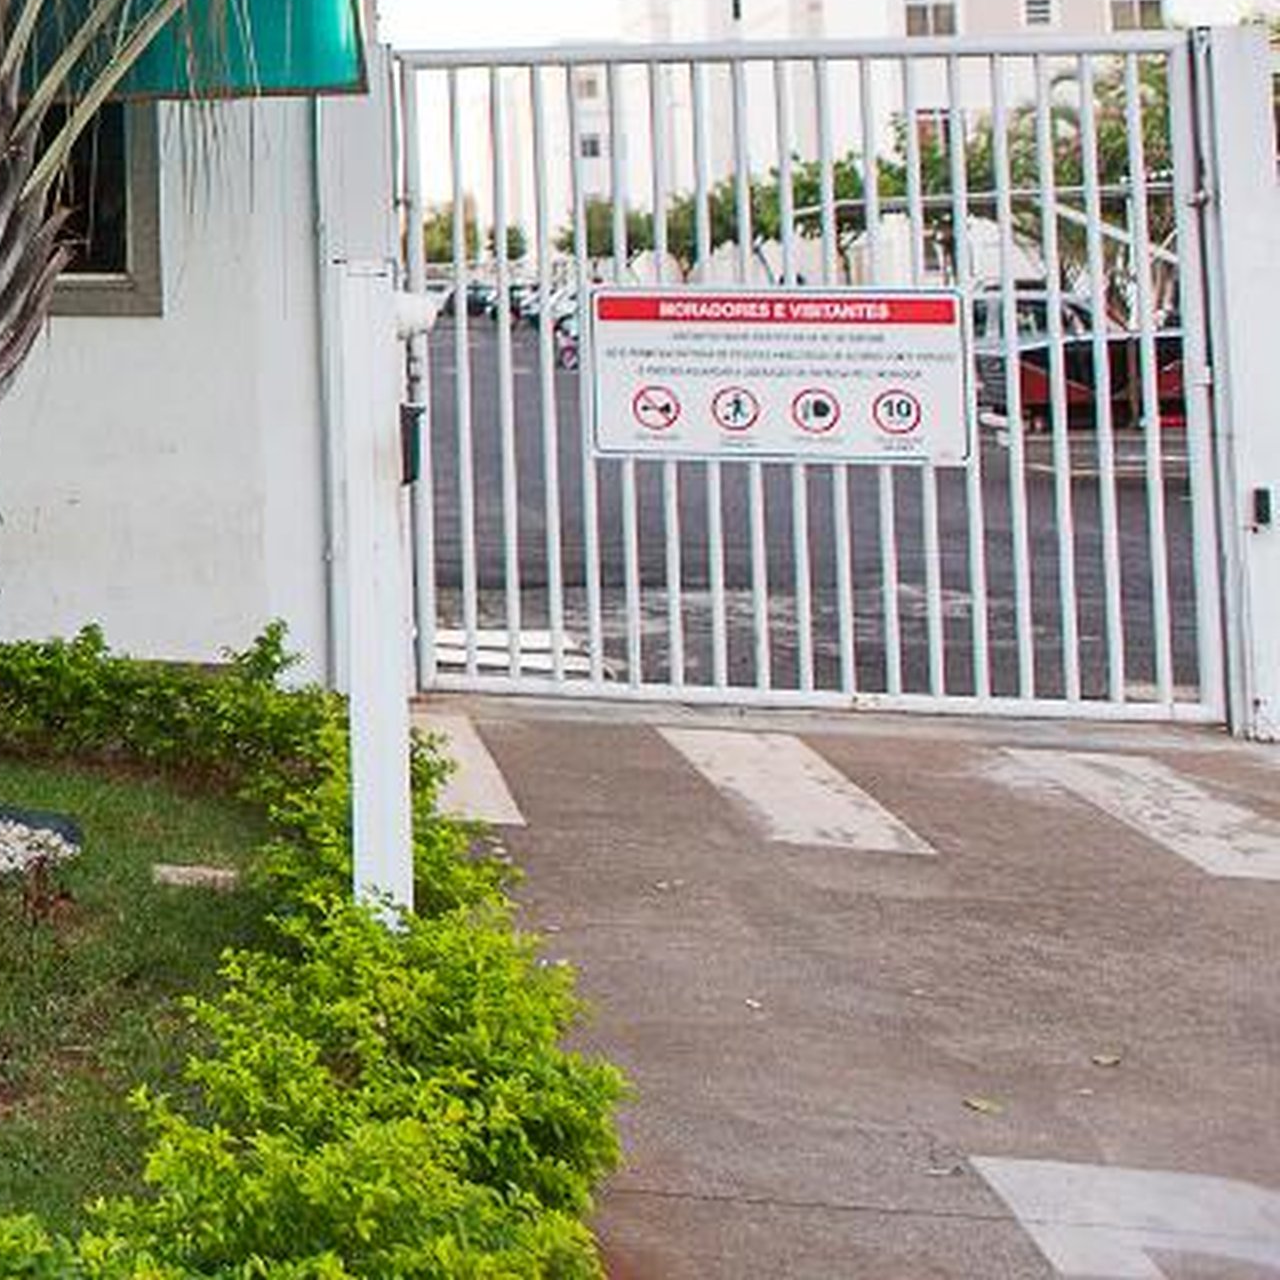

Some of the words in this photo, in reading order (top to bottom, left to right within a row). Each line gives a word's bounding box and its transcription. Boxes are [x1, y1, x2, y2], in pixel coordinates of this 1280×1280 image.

[659, 302, 770, 318] MORADORES
[773, 303, 786, 318] E
[789, 303, 890, 319] VISITANTES
[882, 399, 912, 417] 10
